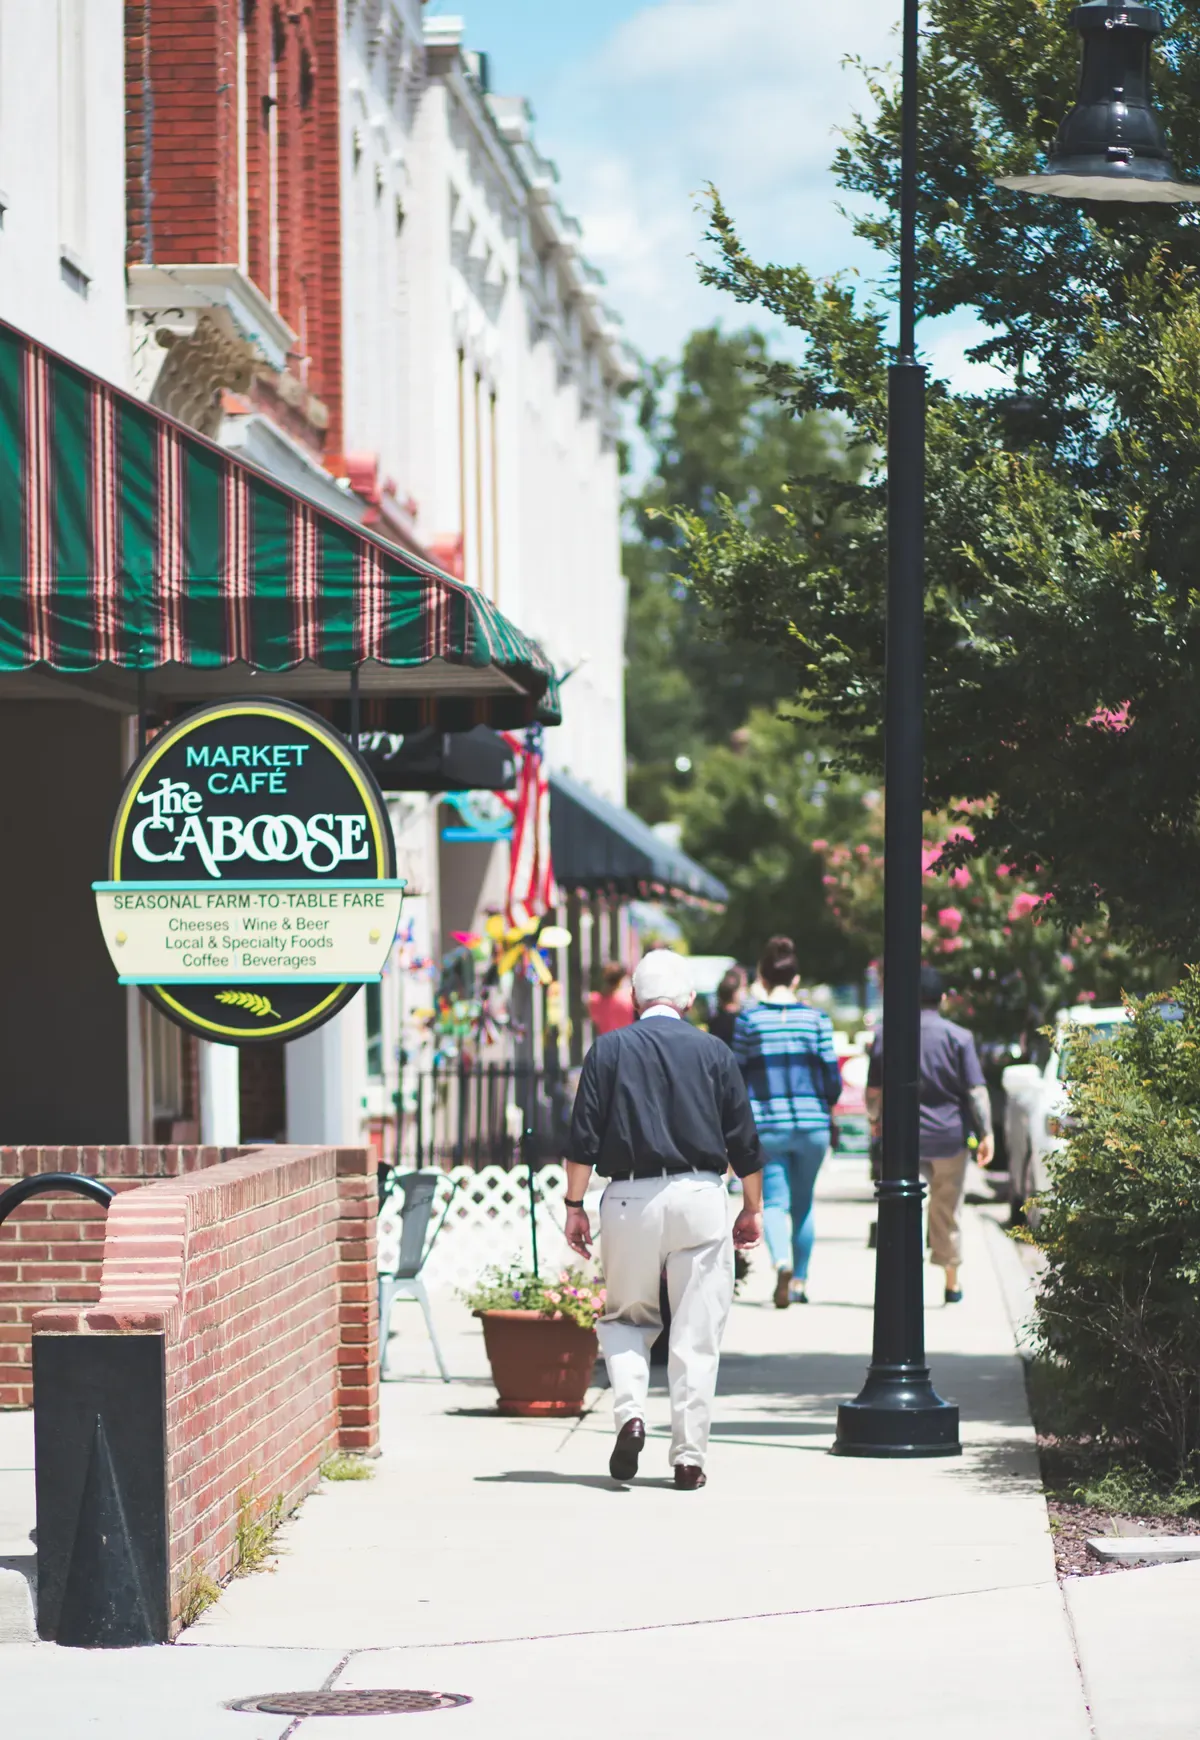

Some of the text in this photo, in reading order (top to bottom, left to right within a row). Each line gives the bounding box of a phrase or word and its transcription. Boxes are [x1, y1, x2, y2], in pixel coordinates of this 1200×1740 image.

[186, 744, 309, 768] MARKET
[343, 731, 404, 760] ery
[207, 767, 288, 795] CAFÉ
[136, 777, 203, 830] The
[132, 813, 369, 878] CABOOSE
[114, 893, 385, 910] SEASONAL FARM-TO-TABLE FARE
[168, 917, 330, 931] Cheeses Wine & Beer
[165, 935, 334, 952] Local & Specialty Foods
[182, 953, 317, 970] Coffee Beverages
